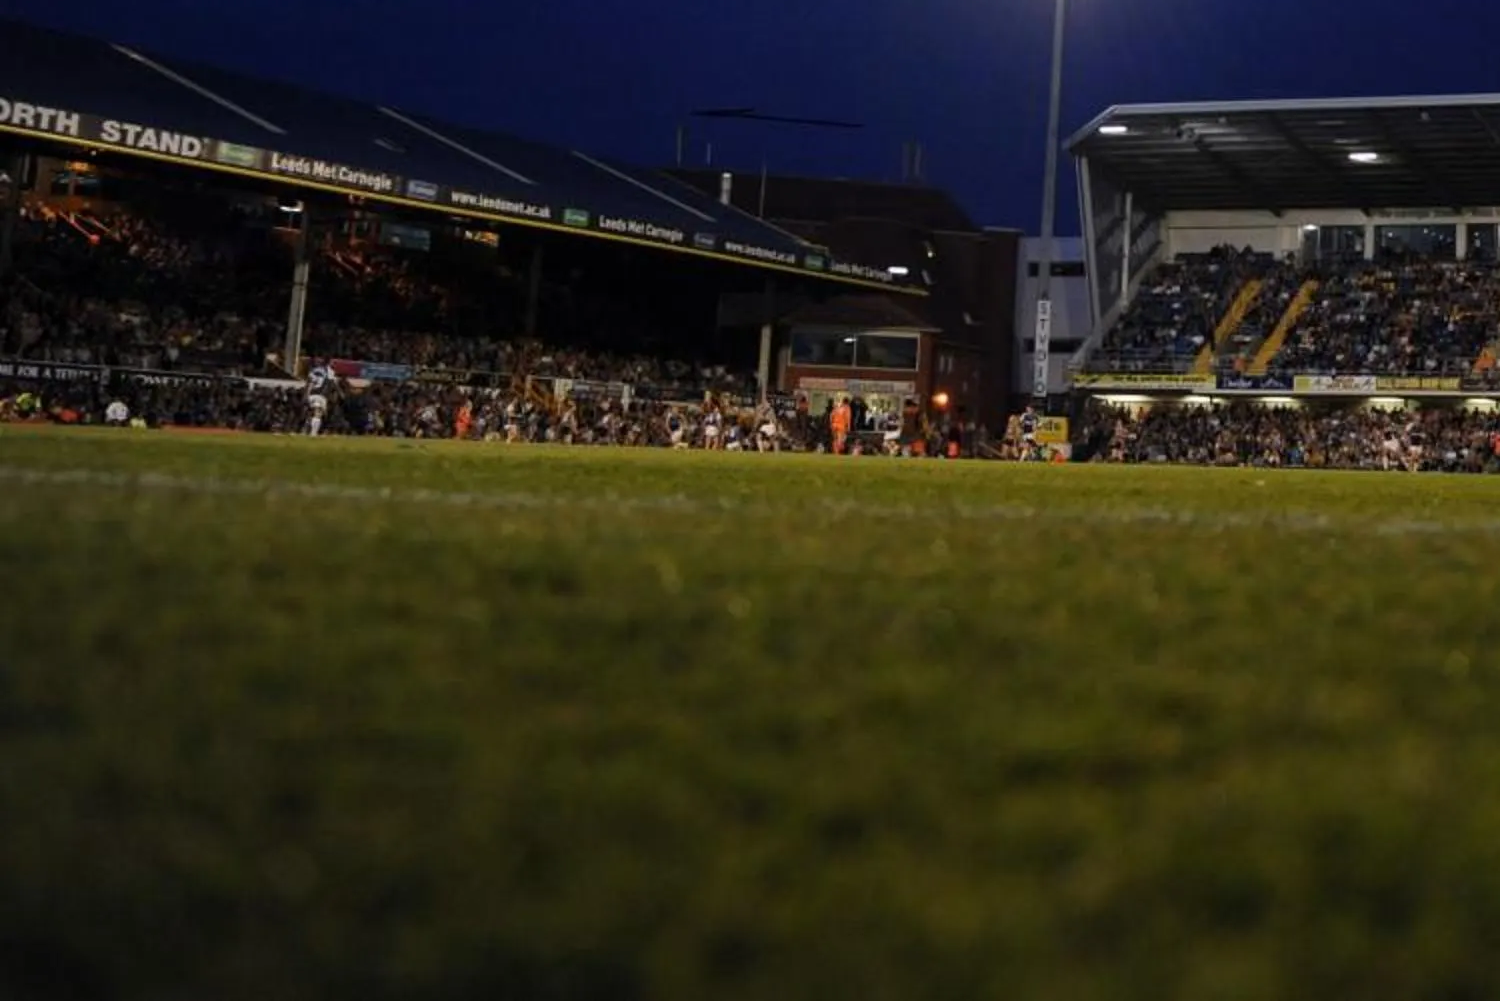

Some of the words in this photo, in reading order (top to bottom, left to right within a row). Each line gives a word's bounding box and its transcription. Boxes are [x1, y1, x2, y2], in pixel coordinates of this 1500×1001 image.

[100, 119, 202, 158] STAND
[271, 151, 310, 174] Leeds
[312, 159, 336, 180] Met
[338, 165, 393, 192] Carnegie
[598, 214, 627, 232] Leeds
